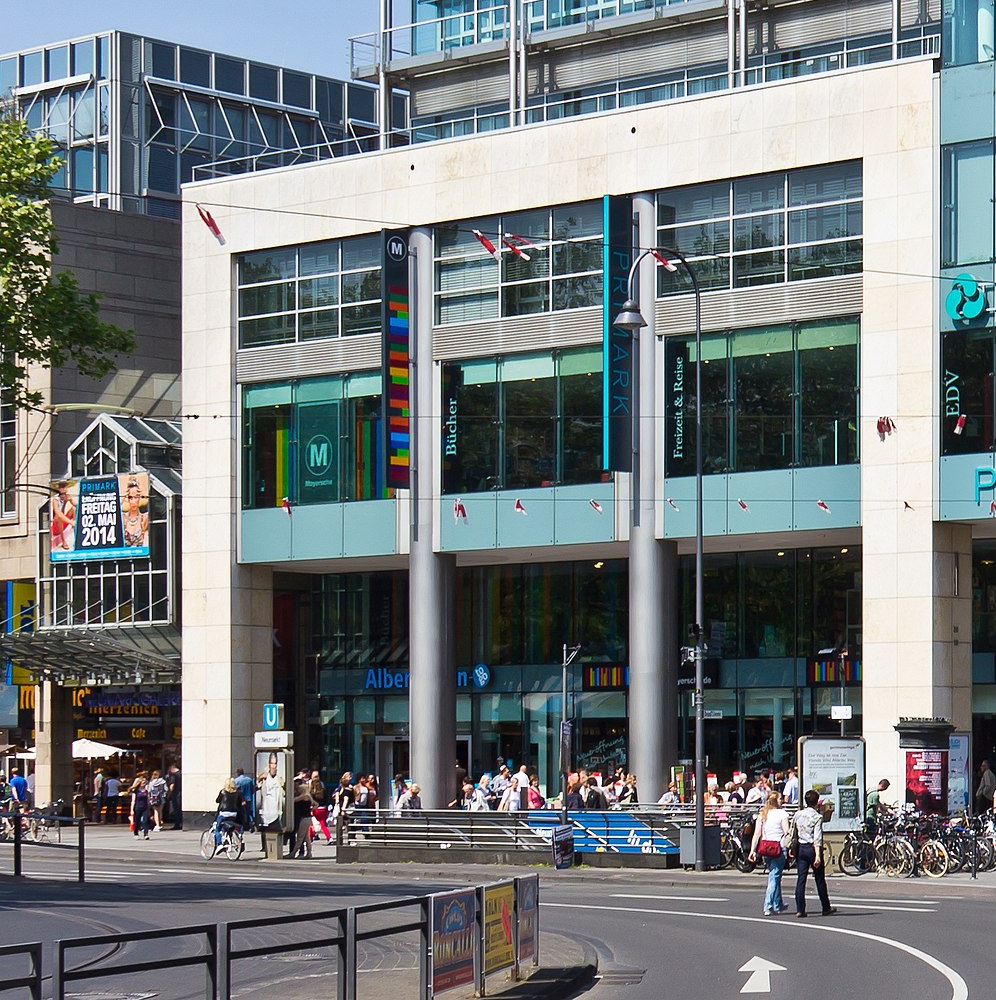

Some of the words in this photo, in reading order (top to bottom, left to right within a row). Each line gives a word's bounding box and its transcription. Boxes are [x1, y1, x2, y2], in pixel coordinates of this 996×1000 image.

[391, 242, 403, 255] M
[673, 356, 684, 386] Reise
[674, 391, 684, 405] &
[946, 370, 960, 417] EDV
[446, 397, 458, 456] Bücher
[673, 409, 684, 459] Freizeit
[310, 443, 328, 467] M
[82, 482, 116, 492] PRIMARK
[82, 501, 117, 514] FREITAG
[82, 515, 96, 527] 02.
[98, 513, 117, 526] MAI
[82, 526, 117, 546] 2014
[365, 668, 410, 689] Alber
[266, 707, 276, 726] U
